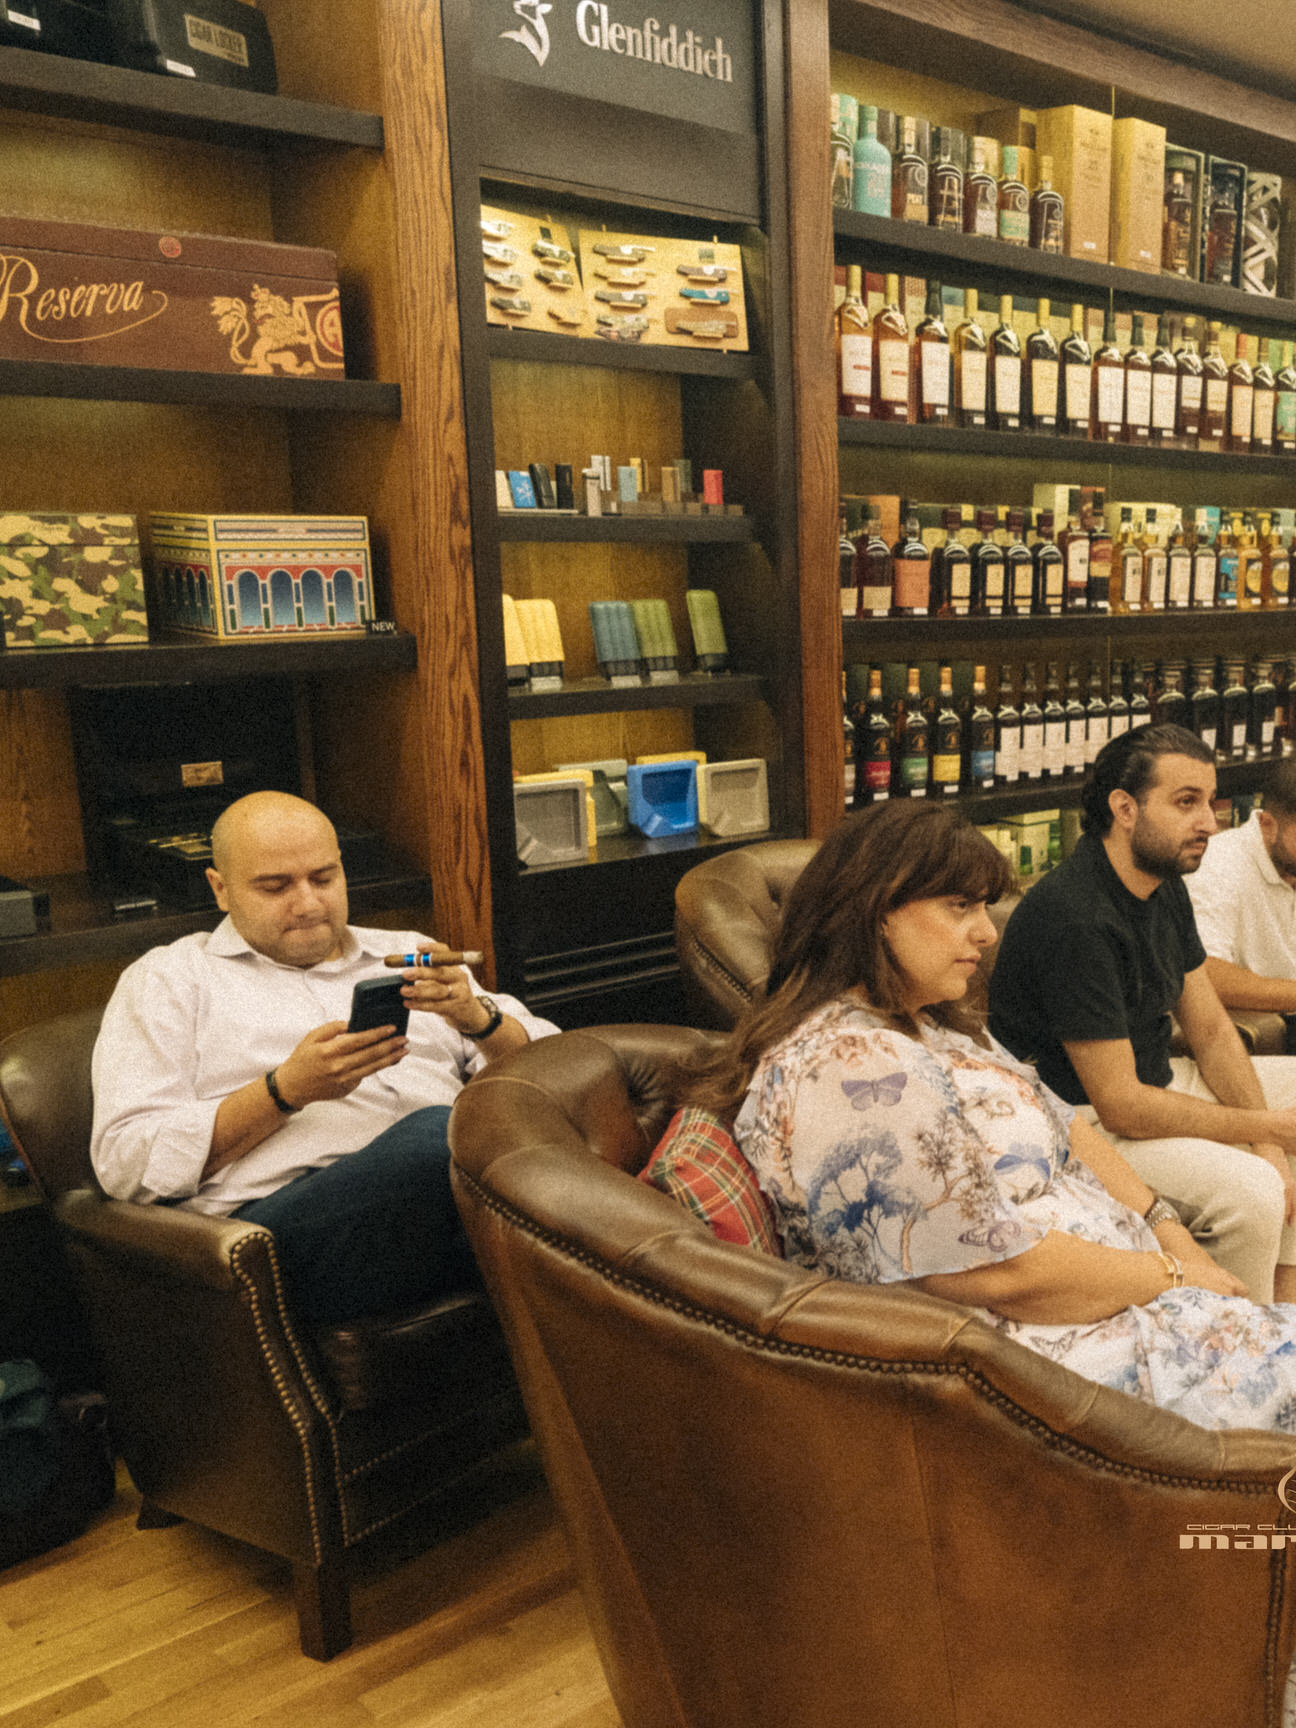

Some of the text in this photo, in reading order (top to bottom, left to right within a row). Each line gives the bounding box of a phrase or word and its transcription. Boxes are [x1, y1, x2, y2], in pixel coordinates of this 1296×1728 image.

[576, 0, 733, 83] Glenfiddich
[0, 254, 168, 343] Reserva
[371, 621, 396, 632] NEW
